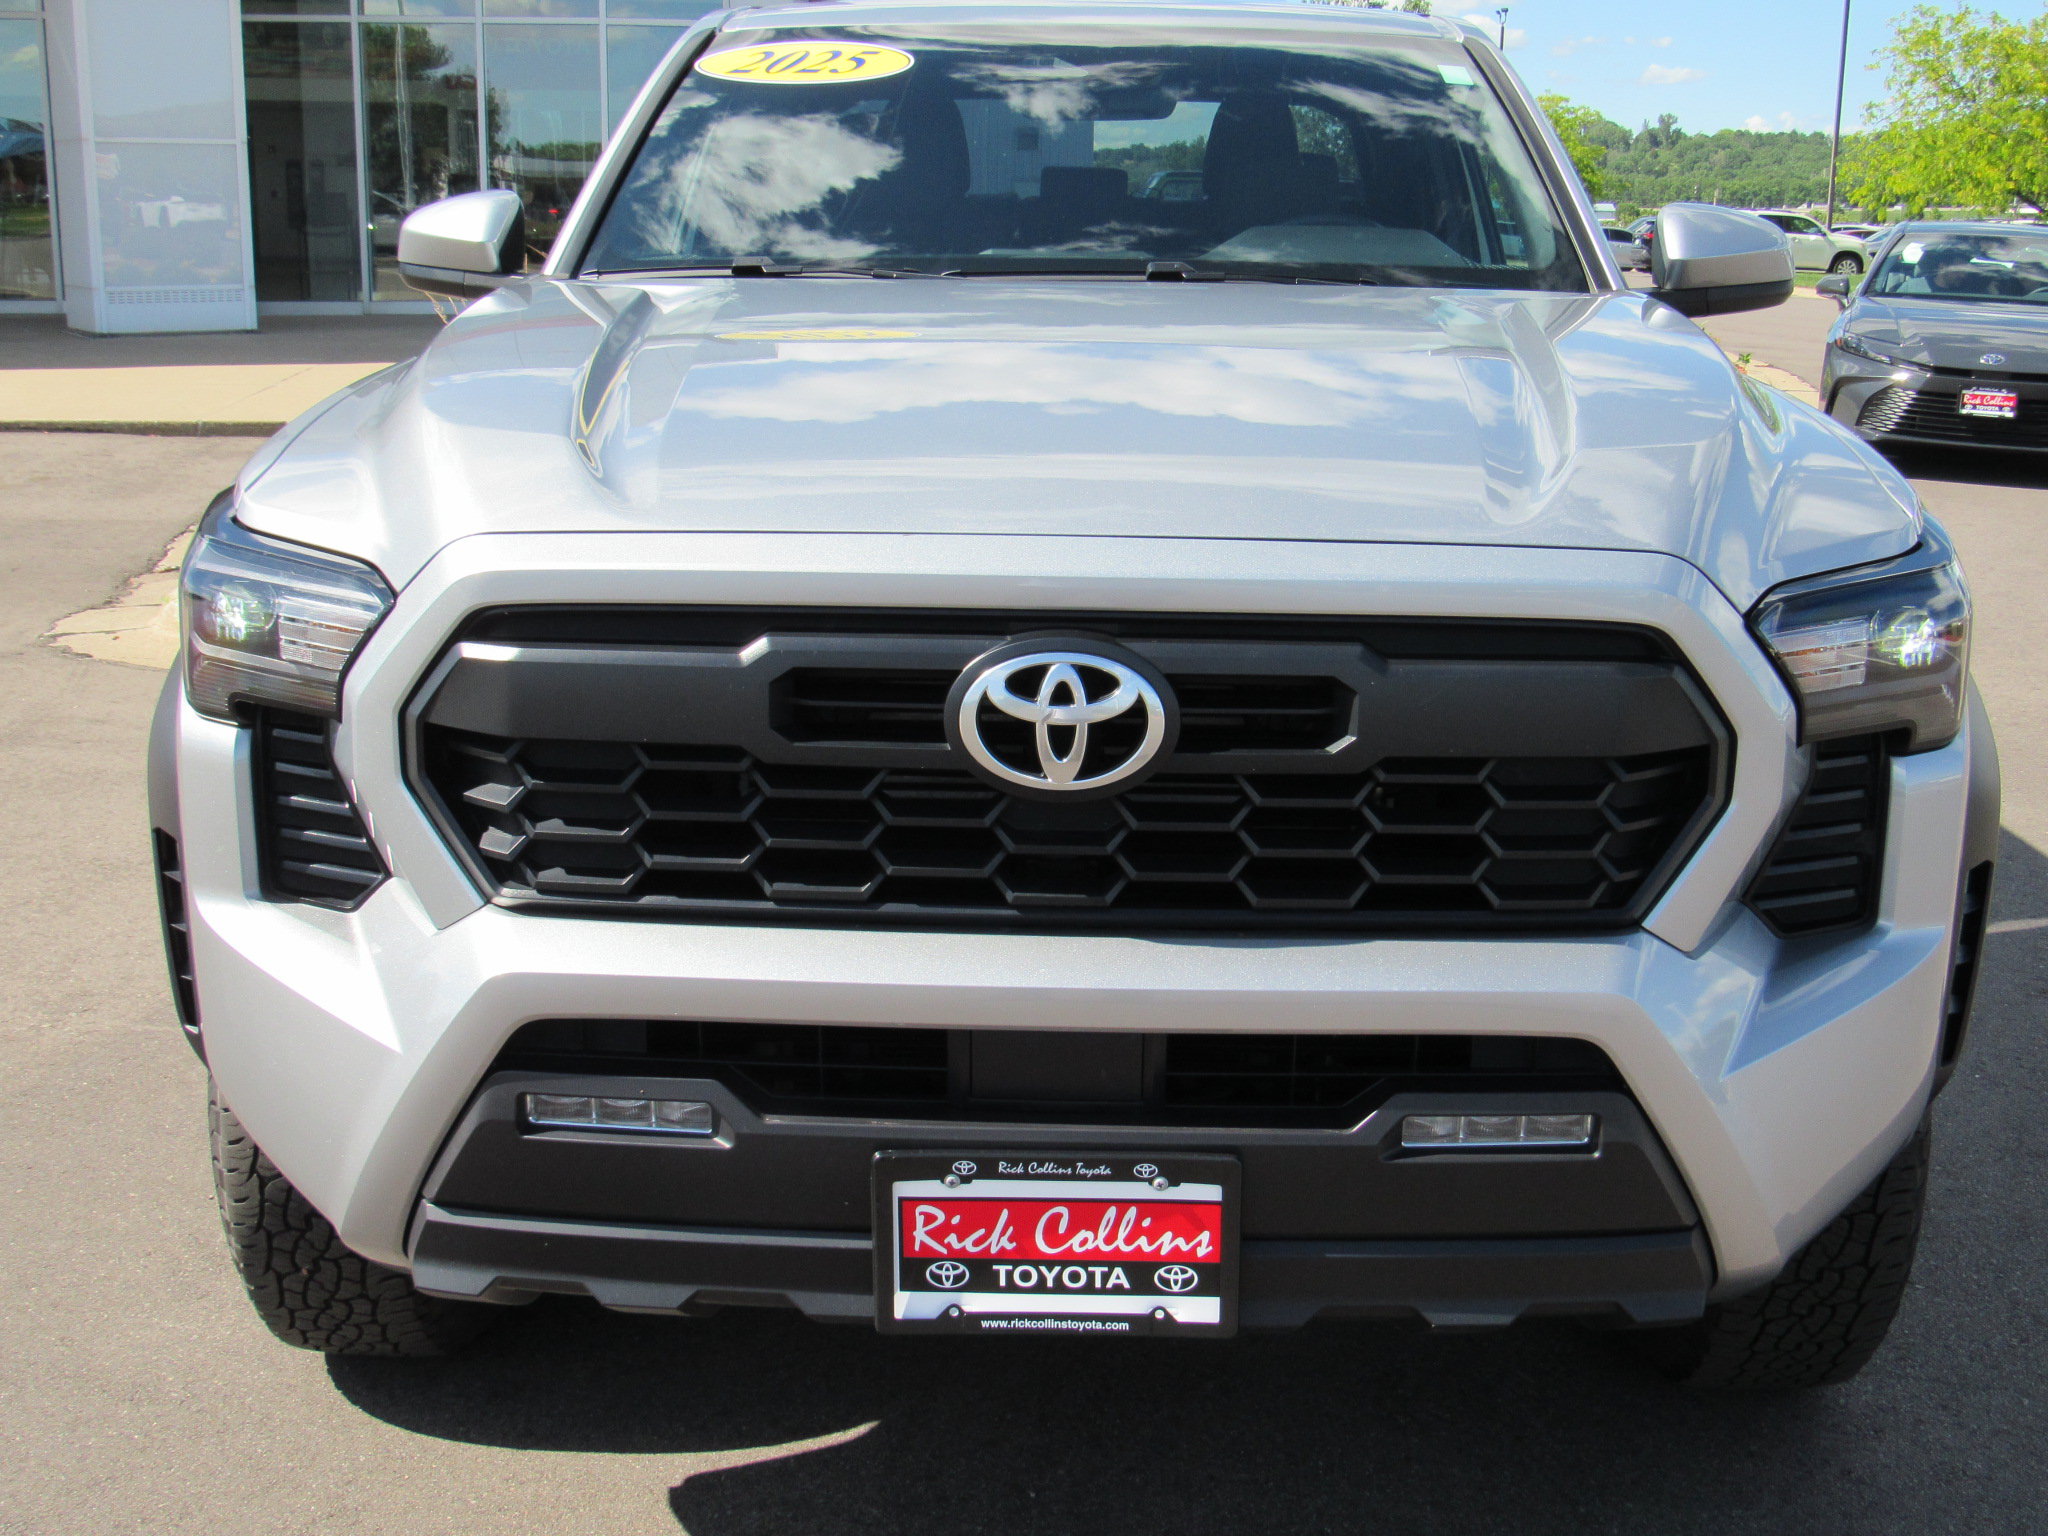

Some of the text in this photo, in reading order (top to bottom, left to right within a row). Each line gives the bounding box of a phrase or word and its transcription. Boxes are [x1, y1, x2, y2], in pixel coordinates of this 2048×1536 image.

[726, 50, 880, 74] 2025
[998, 1161, 1112, 1176] Rick Collins Toyota
[912, 1204, 1214, 1258] Rick Collins
[992, 1264, 1131, 1289] TOYOTA
[980, 1317, 1130, 1331] www.rickcollinstoyota.com
